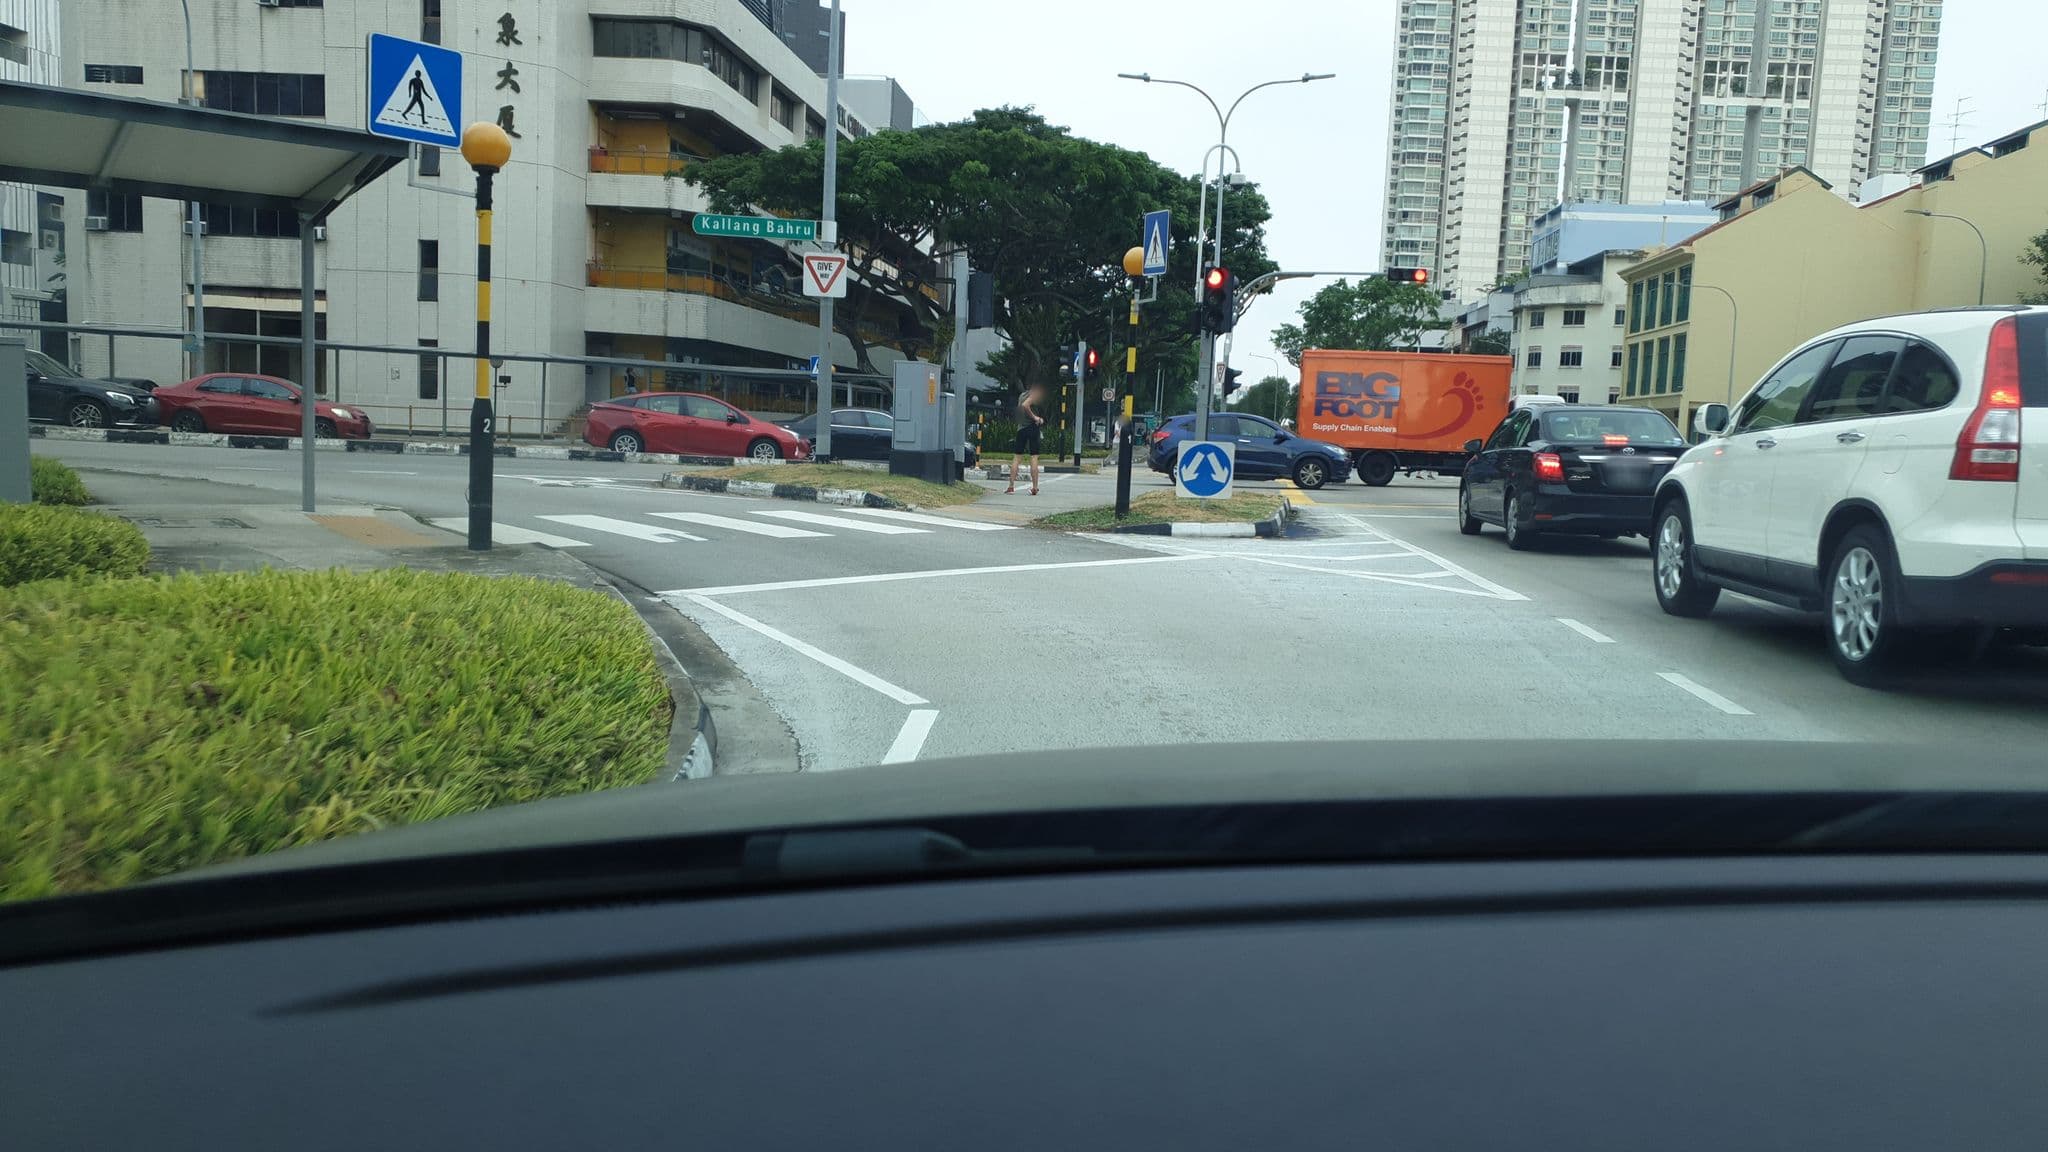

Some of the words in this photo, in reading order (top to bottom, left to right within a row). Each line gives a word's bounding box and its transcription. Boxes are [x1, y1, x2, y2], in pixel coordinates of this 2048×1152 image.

[702, 216, 760, 235] Kallang
[766, 220, 811, 236] Bahru
[817, 262, 833, 271] GIVE
[1315, 371, 1400, 400] BIG
[1314, 400, 1399, 419] FOOT
[483, 418, 490, 433] 2
[1312, 422, 1339, 432] Supply
[1340, 423, 1362, 432] Chain
[1363, 425, 1397, 433] Enablers
